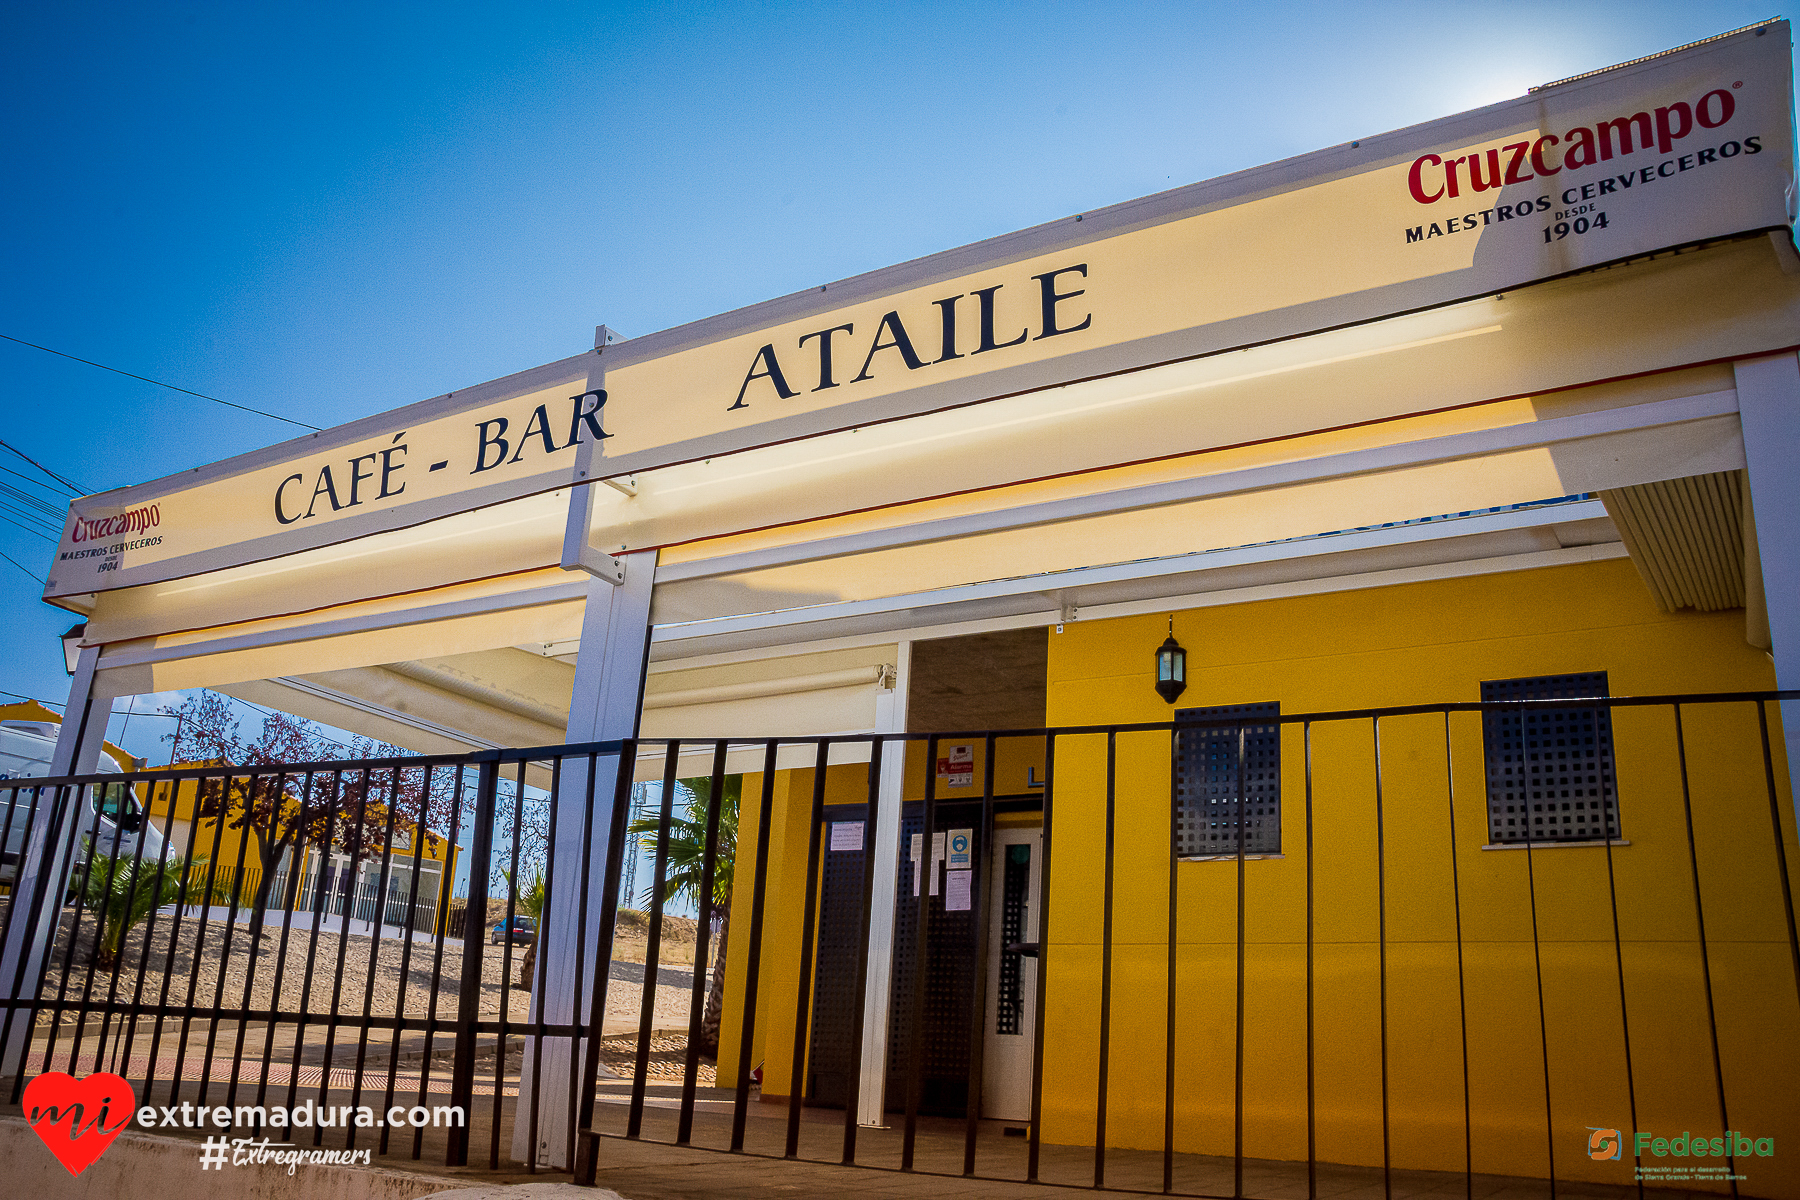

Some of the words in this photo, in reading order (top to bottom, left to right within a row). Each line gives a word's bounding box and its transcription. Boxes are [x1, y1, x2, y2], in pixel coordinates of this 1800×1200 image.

[1407, 87, 1736, 205] Cruzcampo
[1405, 195, 1552, 244] MAESTROS
[1561, 135, 1763, 205] CERVECEROS
[1542, 211, 1610, 244] 1904
[1554, 203, 1597, 221] DESDE
[274, 431, 408, 526] CAFÉ
[469, 388, 615, 475] BAR
[726, 263, 1092, 411] ATAILE
[72, 504, 160, 543] Cruzcampo
[60, 546, 108, 561] MAESTROS
[109, 535, 163, 554] CERVECEROS
[97, 561, 118, 573] 1904
